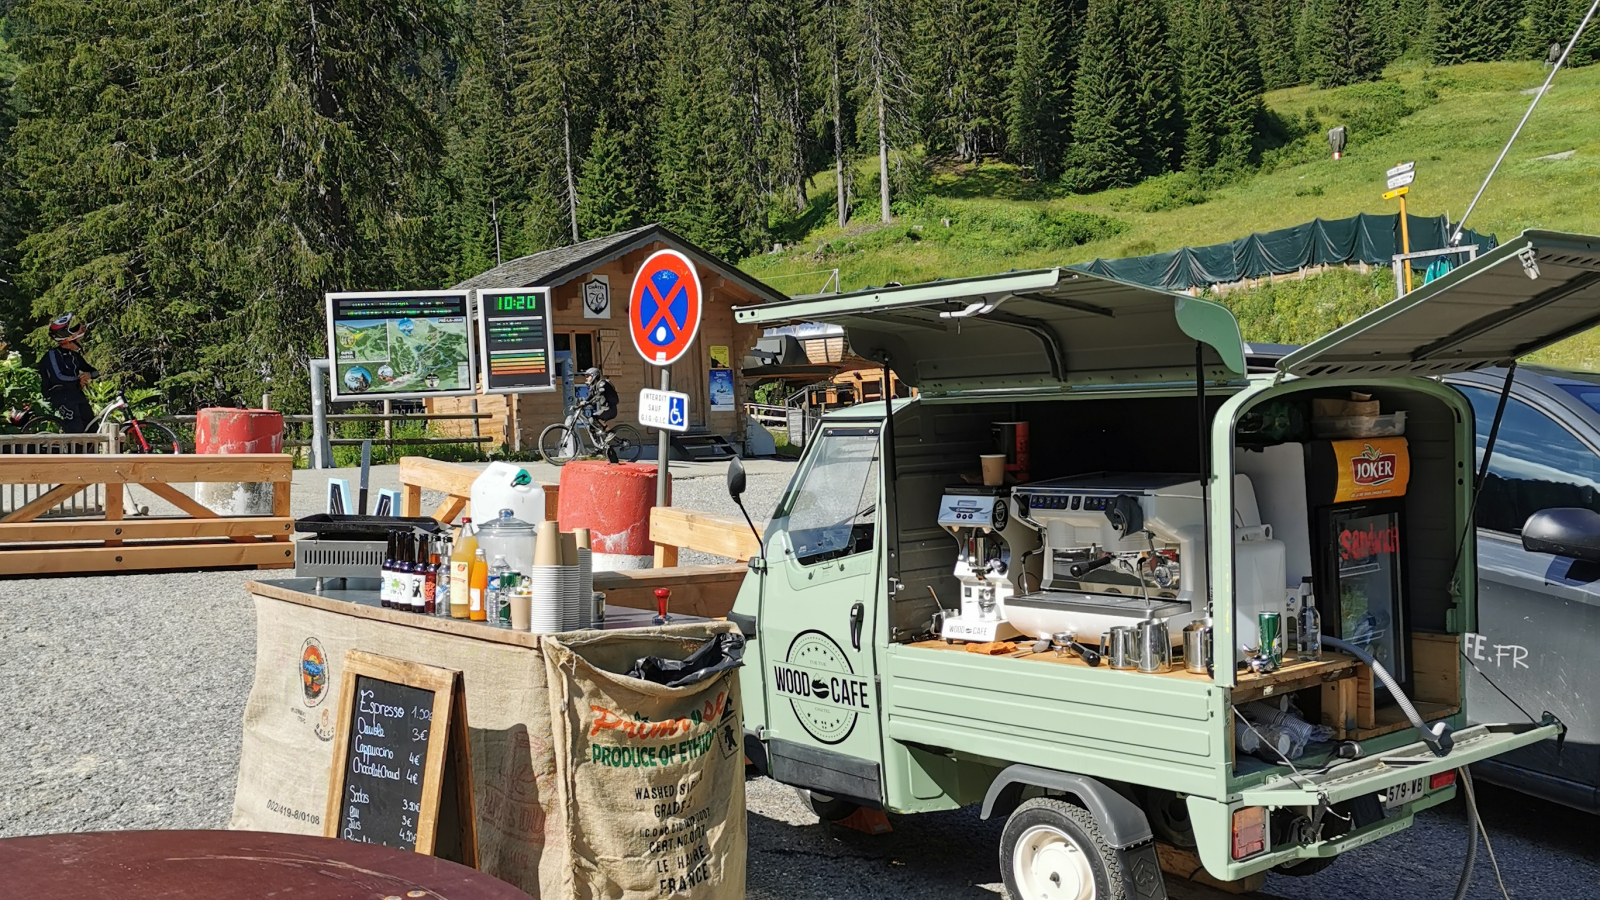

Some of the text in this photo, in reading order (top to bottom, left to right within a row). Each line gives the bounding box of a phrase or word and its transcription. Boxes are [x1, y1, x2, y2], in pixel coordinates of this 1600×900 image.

[498, 296, 536, 310] 10:20
[643, 393, 667, 402] INTERDIT
[648, 404, 661, 412] SAUF
[1357, 461, 1392, 480] JOKER
[949, 624, 987, 636] WOOD CAFE
[774, 665, 869, 708] WOOD CAFE
[360, 690, 405, 727] Espresso
[412, 728, 428, 742] 3€
[355, 734, 394, 764] Cappuccino
[408, 752, 420, 766] 4€
[592, 743, 657, 768] PRODUCE
[658, 744, 676, 766] OF
[406, 768, 418, 785] 4€
[349, 784, 370, 804] Sodas
[635, 785, 675, 799] WASHED
[266, 798, 320, 825] 002/419-8/0108
[401, 815, 412, 827] 3€
[657, 859, 669, 873] LE
[660, 862, 709, 895] FRANCE
